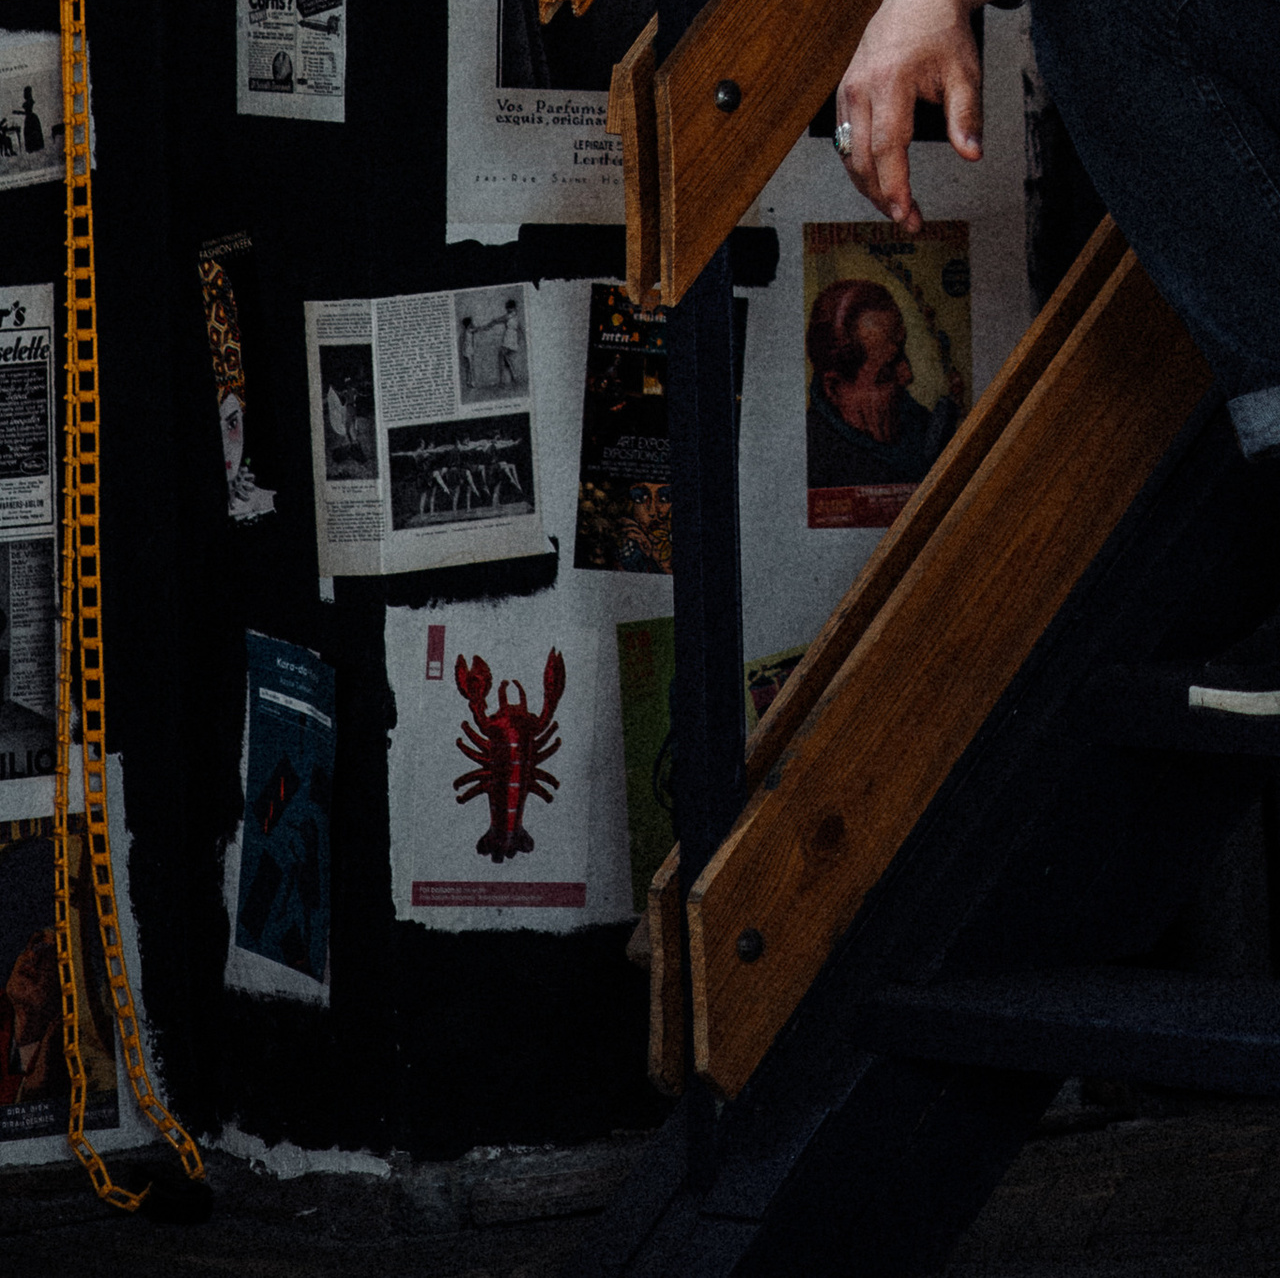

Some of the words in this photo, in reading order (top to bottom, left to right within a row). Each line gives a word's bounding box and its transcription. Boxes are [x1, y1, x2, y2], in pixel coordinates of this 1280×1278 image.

[497, 98, 524, 113] Vos
[536, 99, 607, 115] Parfums
[233, 237, 253, 250] WEEK
[617, 435, 636, 448] ART
